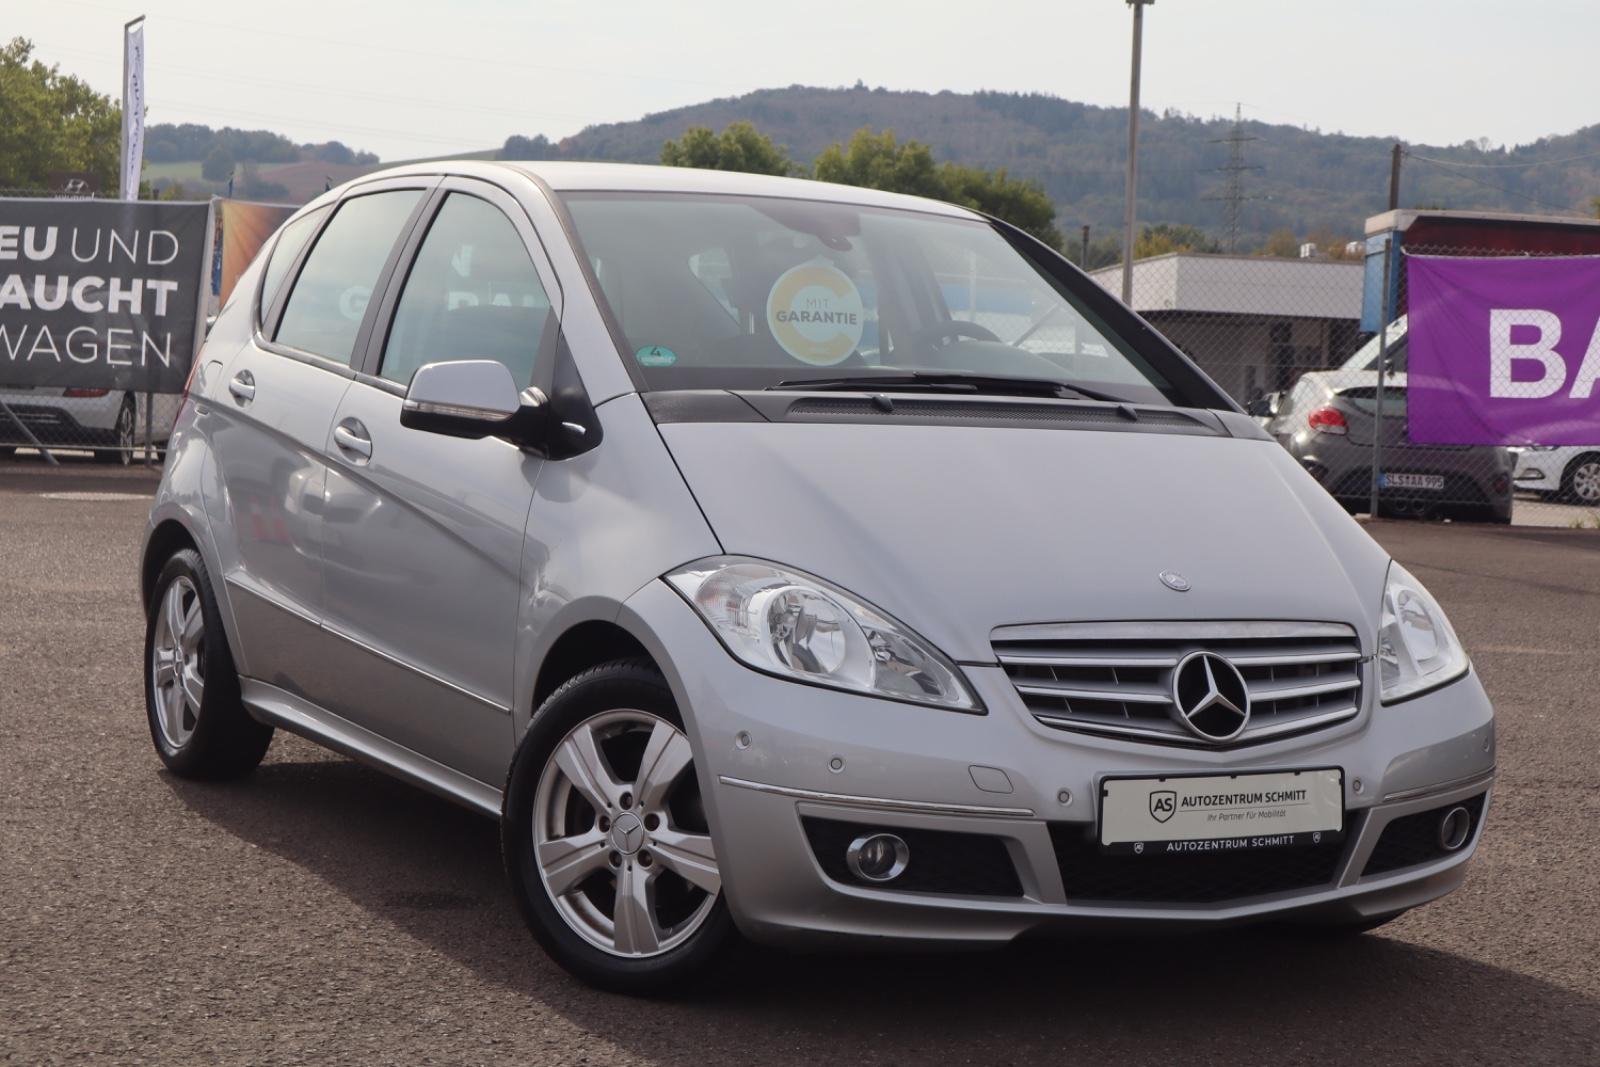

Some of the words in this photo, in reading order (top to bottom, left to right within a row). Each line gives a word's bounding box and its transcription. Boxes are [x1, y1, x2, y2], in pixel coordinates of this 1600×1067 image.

[0, 225, 58, 261] EU
[71, 227, 179, 265] UND
[0, 274, 178, 317] AUCHT
[806, 297, 830, 310] MIT
[776, 310, 857, 326] GARANTIE
[1153, 797, 1173, 812] AS
[1181, 792, 1263, 807] AUTOZENTRUM
[1264, 789, 1307, 803] SCHMITT
[1218, 811, 1244, 821] Partner
[1166, 839, 1248, 852] AUTOZENTRUM
[1251, 835, 1295, 847] SCHMITT
